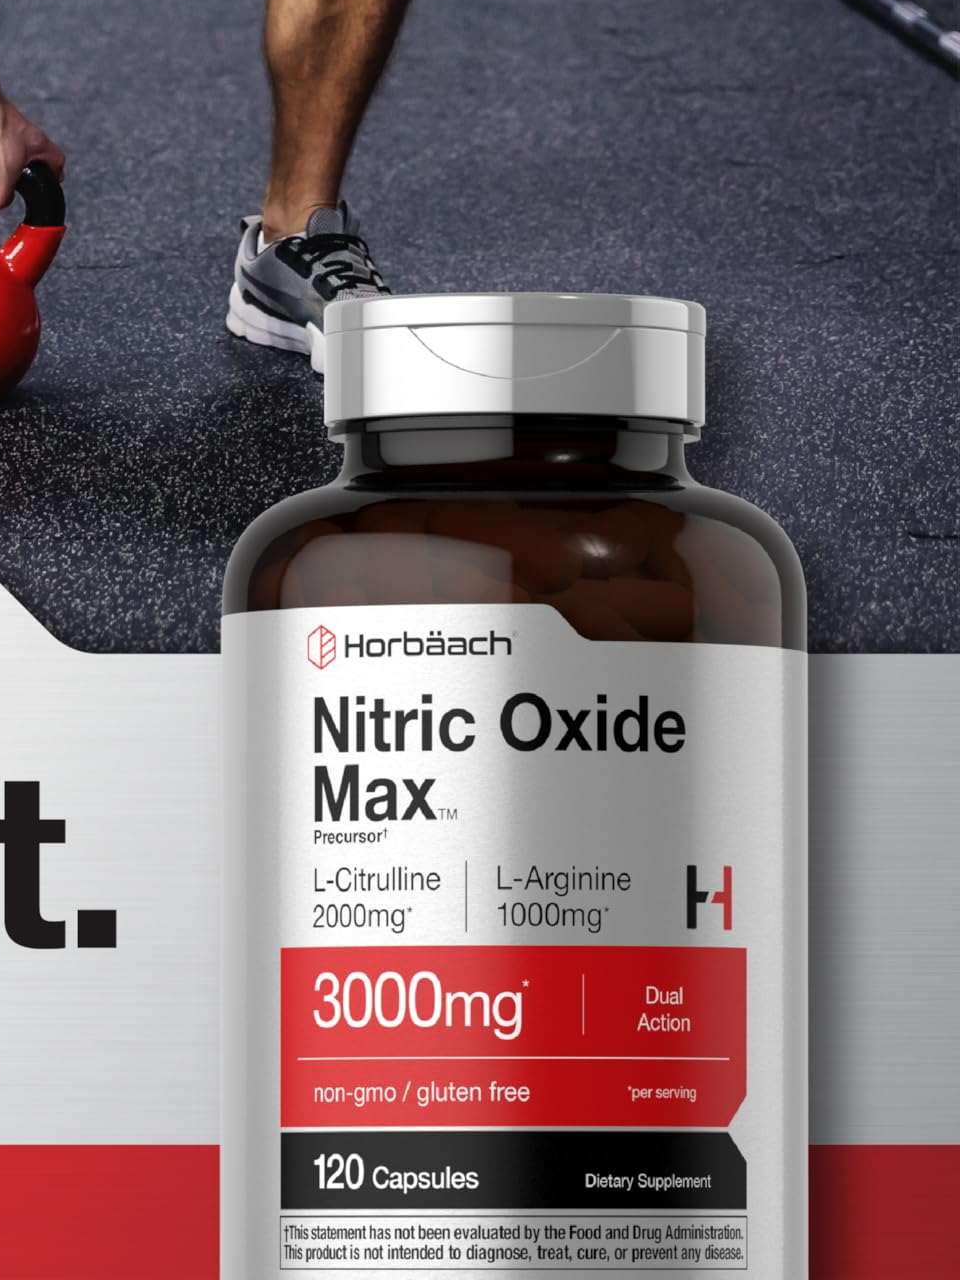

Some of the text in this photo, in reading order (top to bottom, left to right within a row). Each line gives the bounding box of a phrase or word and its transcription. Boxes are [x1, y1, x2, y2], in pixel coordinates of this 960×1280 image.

[314, 692, 686, 754] Nitric Oxide
[314, 866, 441, 893] L-Citrulline
[497, 865, 632, 897] L-Arginine
[645, 985, 684, 1006] Dual
[637, 1012, 691, 1033] Action
[314, 1082, 397, 1108] non-gmo
[416, 1080, 482, 1108] gluten
[488, 1080, 531, 1103] free
[655, 1084, 697, 1103] serving
[313, 1153, 480, 1195] 120 Capsules
[584, 1172, 712, 1193] Dietary Supplement
[311, 1224, 367, 1240] statement
[369, 1224, 391, 1240] has
[394, 1224, 416, 1240] not
[418, 1224, 451, 1240] been
[453, 1224, 521, 1240] evaluated
[524, 1224, 540, 1243] by
[544, 1224, 566, 1240] the
[569, 1224, 602, 1240] Food
[605, 1224, 629, 1240] and
[632, 1224, 662, 1243] Drug
[665, 1224, 744, 1240] Administration.
[283, 1244, 744, 1263] This product is not intended to diagnose, treat, cure, or prevent any disease.
